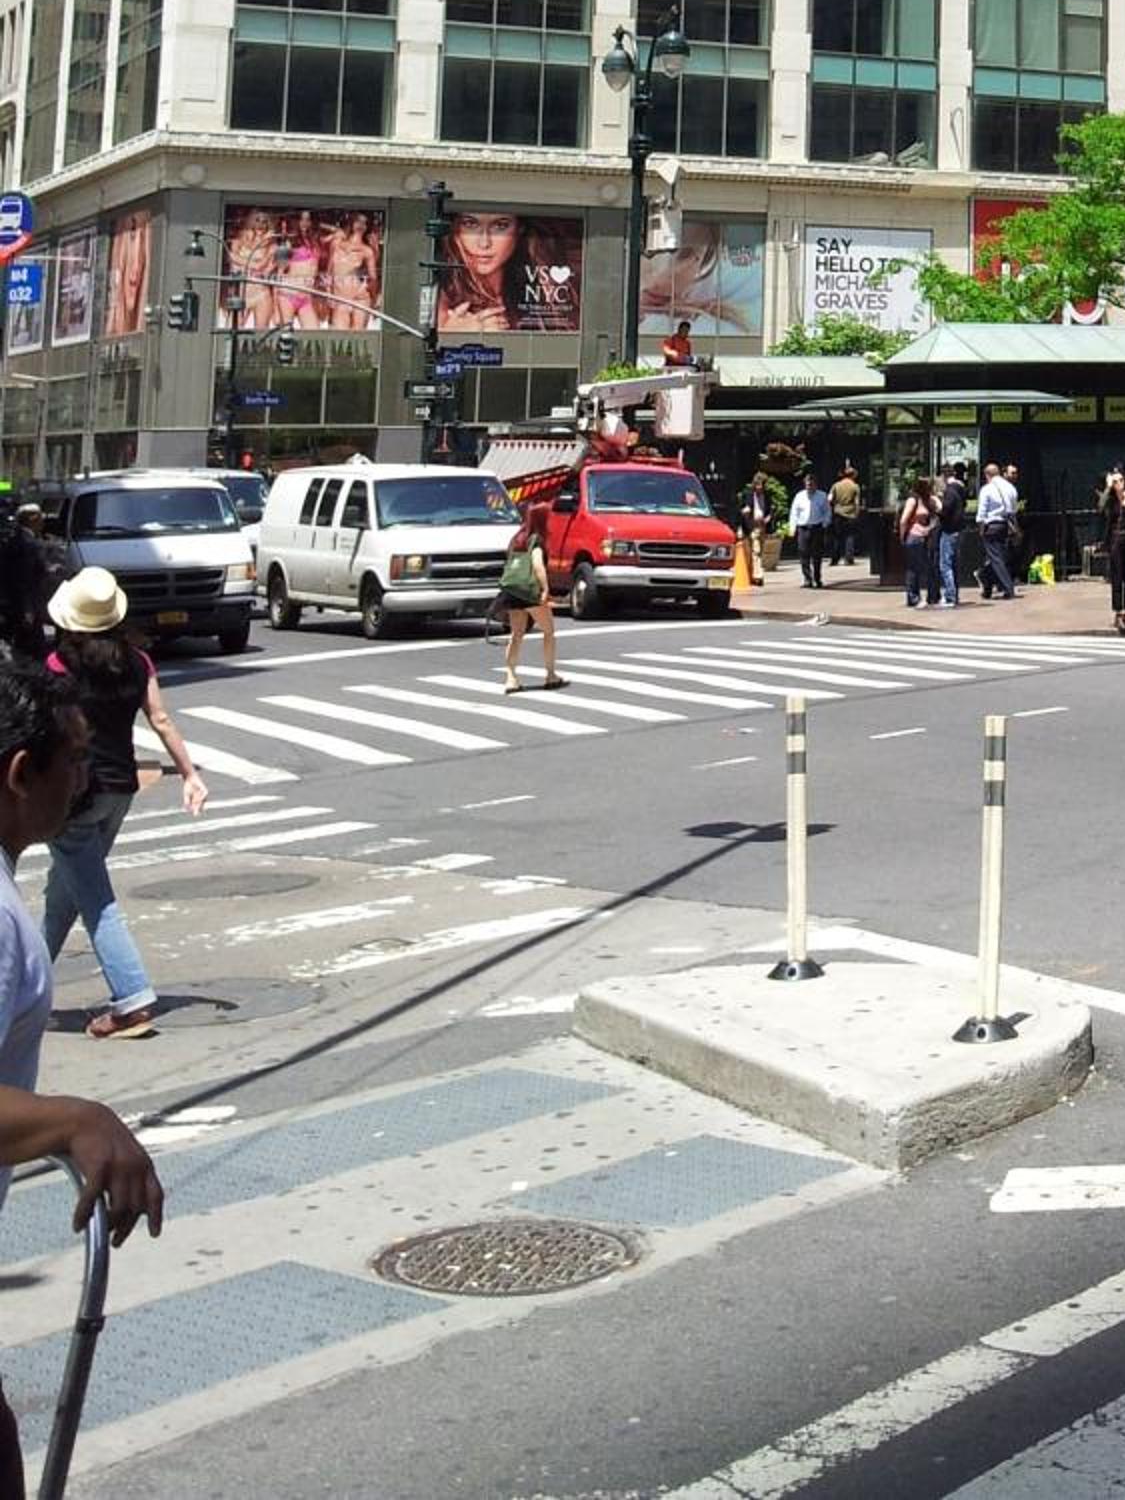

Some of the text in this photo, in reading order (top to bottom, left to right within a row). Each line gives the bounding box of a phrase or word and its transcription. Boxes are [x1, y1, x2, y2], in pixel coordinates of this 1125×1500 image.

[817, 238, 852, 254] SAY
[815, 256, 902, 274] HELLO TO
[525, 265, 550, 285] VS
[525, 285, 569, 303] NYC
[815, 293, 888, 310] GRAVES
[750, 376, 825, 387] PUBLIC TOILET
